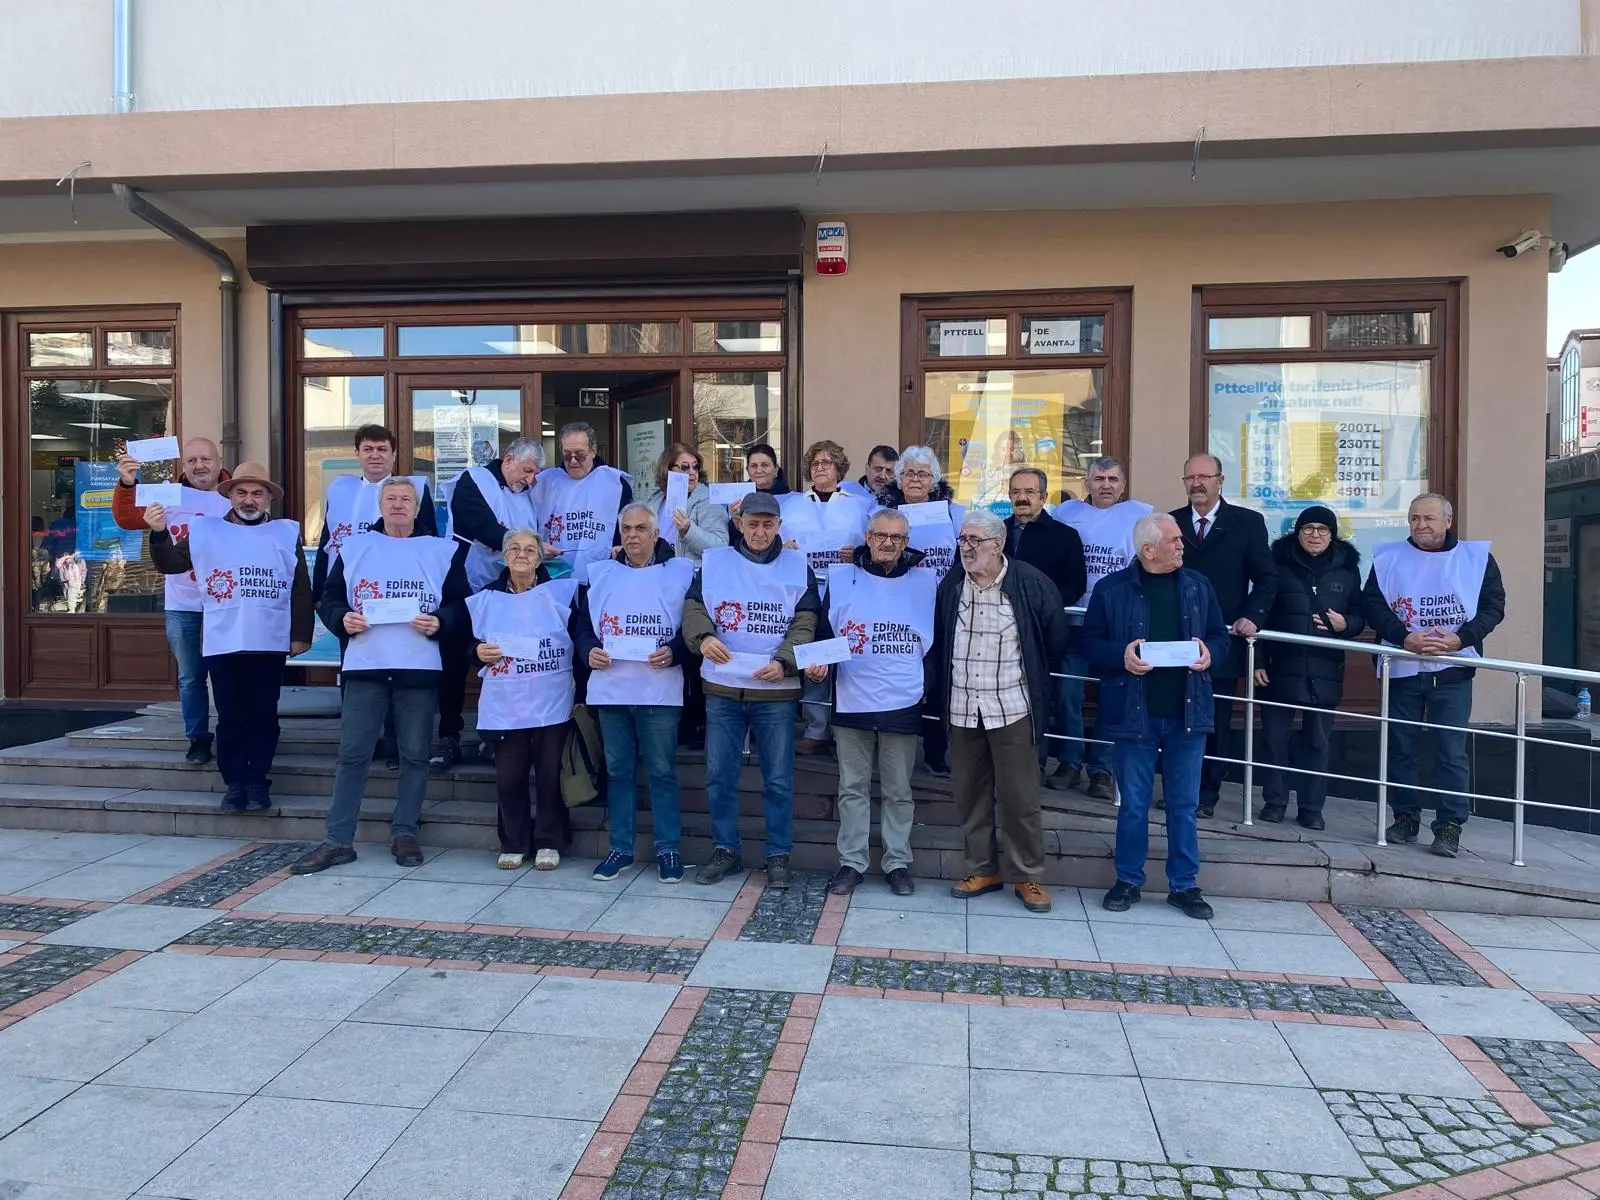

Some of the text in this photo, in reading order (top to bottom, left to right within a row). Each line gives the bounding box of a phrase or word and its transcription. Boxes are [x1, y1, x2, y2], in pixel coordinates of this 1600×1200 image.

[944, 328, 984, 336] PTTCELL
[1034, 339, 1075, 347] AVANTAJ
[1340, 423, 1380, 433] 200TL
[1339, 440, 1380, 449] 230TL
[1339, 457, 1380, 467] 270TL
[1338, 472, 1379, 481] 350TL
[1337, 487, 1379, 497] 450TL
[240, 565, 274, 577] EDİRNE
[240, 577, 288, 589] EMEKLİLER
[386, 578, 425, 590] EDİRNE
[241, 588, 280, 599] DERNEĞİ
[1420, 594, 1456, 606] EDİRNE
[747, 601, 783, 612] EDİRNE
[1420, 604, 1466, 616] EMEKLİLE
[626, 613, 662, 624] EDİRNE
[873, 621, 911, 632] EDİRNE
[872, 643, 914, 654] DERNEĞİ
[517, 659, 560, 674] DERNEĞİ
